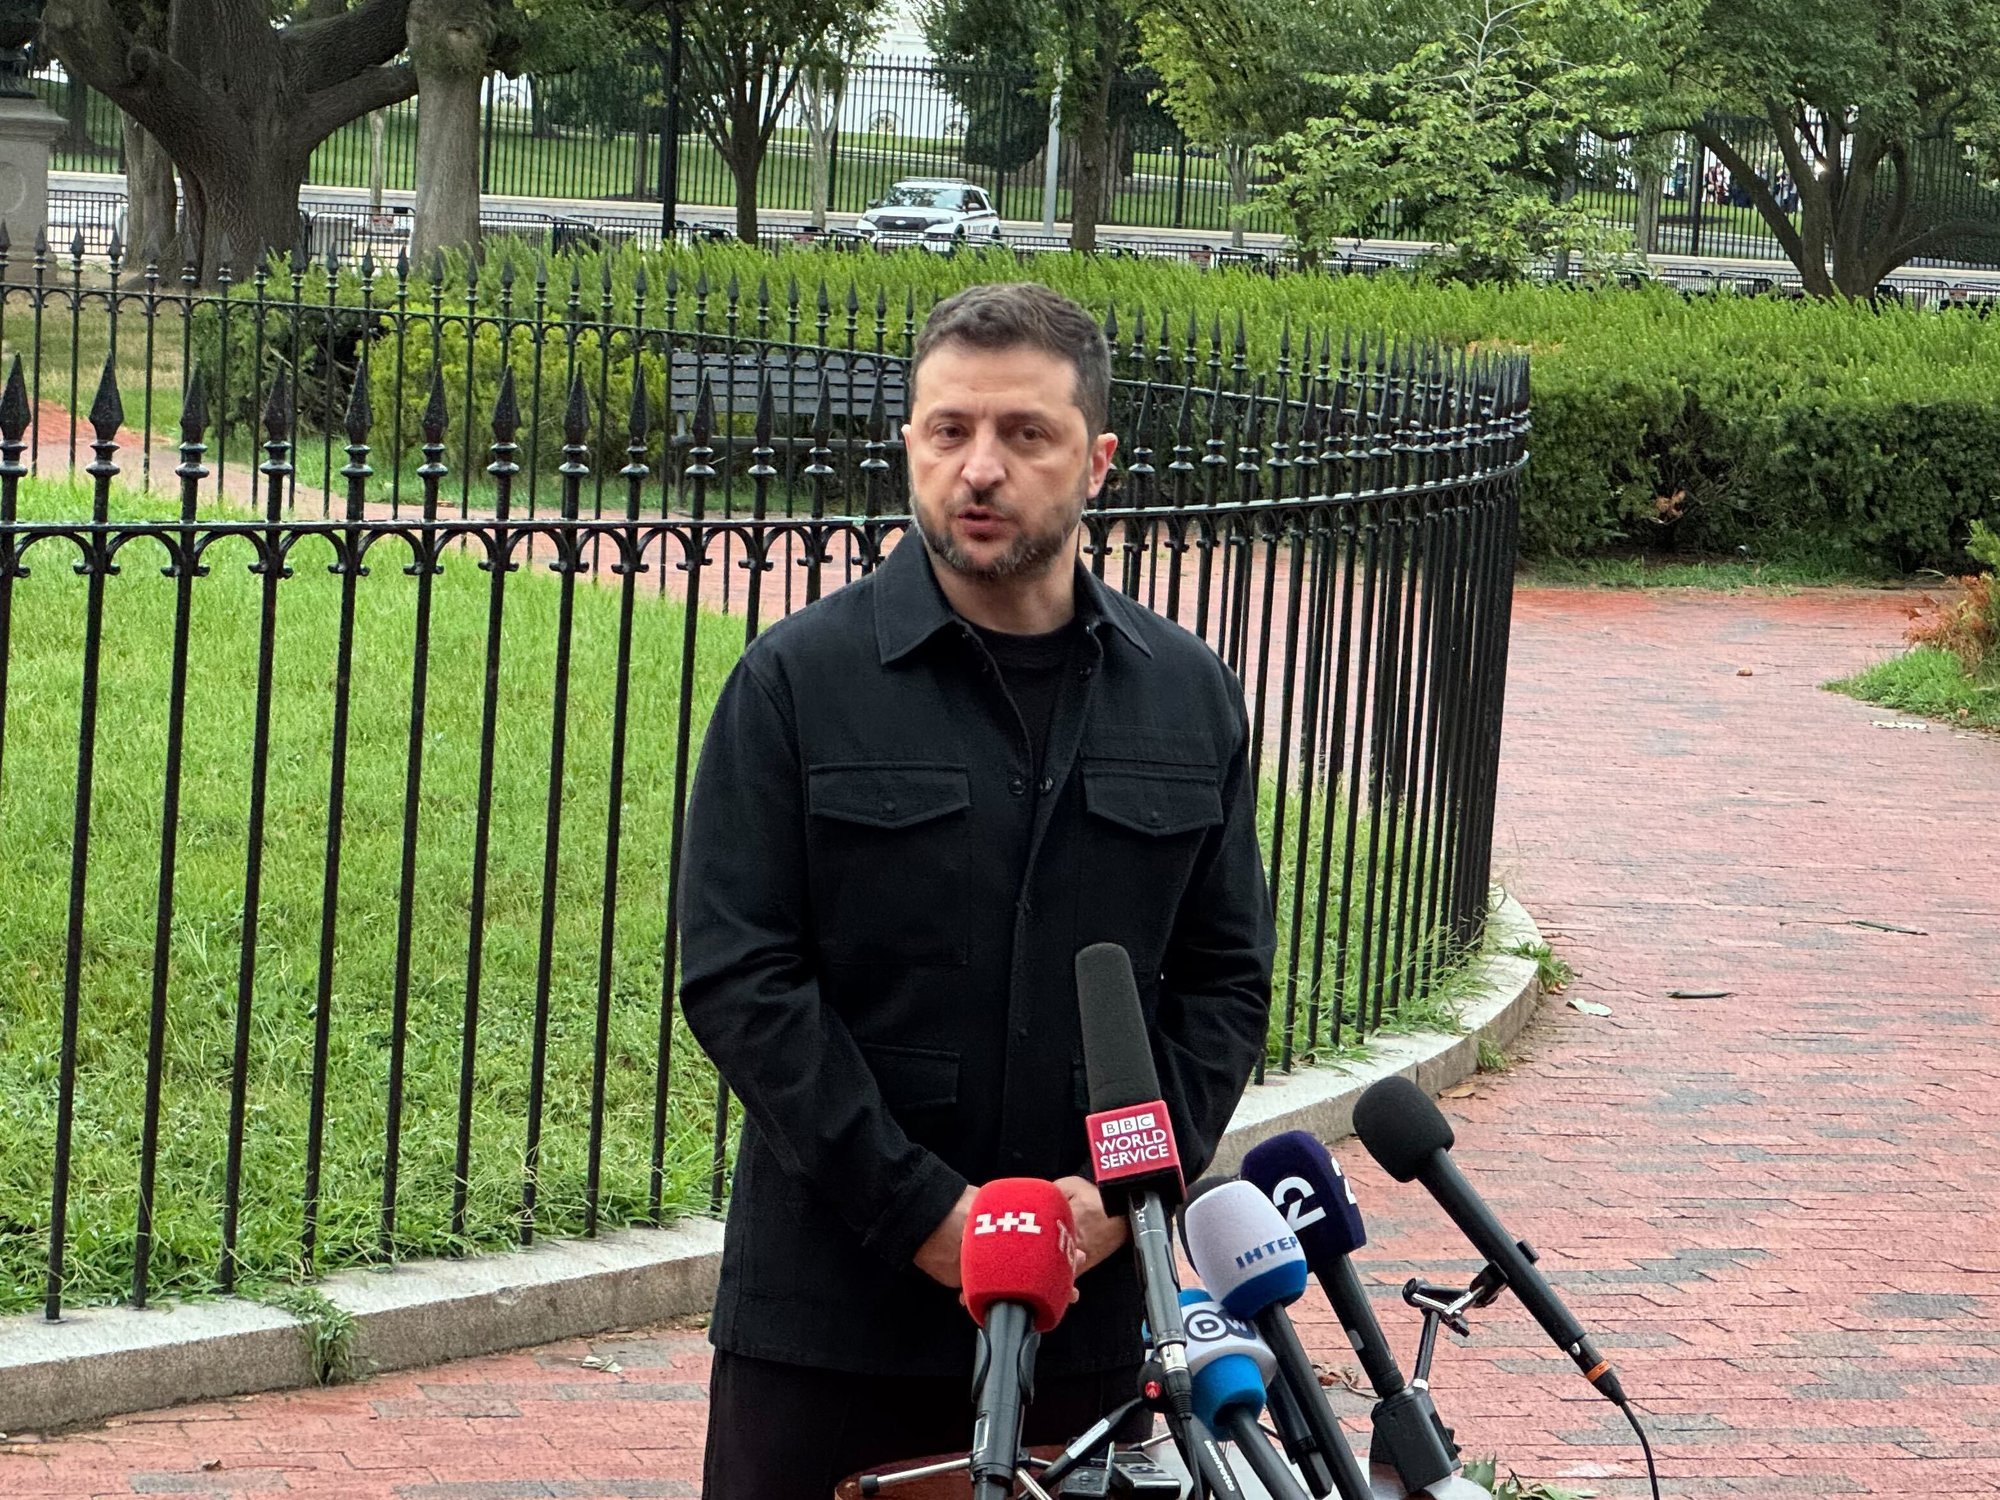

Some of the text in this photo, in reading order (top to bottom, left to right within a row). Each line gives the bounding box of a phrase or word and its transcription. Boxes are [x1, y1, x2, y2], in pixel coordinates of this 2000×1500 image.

[1104, 1115, 1153, 1135] BBC
[1095, 1129, 1167, 1155] WORLD
[1100, 1143, 1170, 1170] SERVICE
[1272, 1176, 1327, 1232] 2
[974, 1211, 1042, 1235] 1+1
